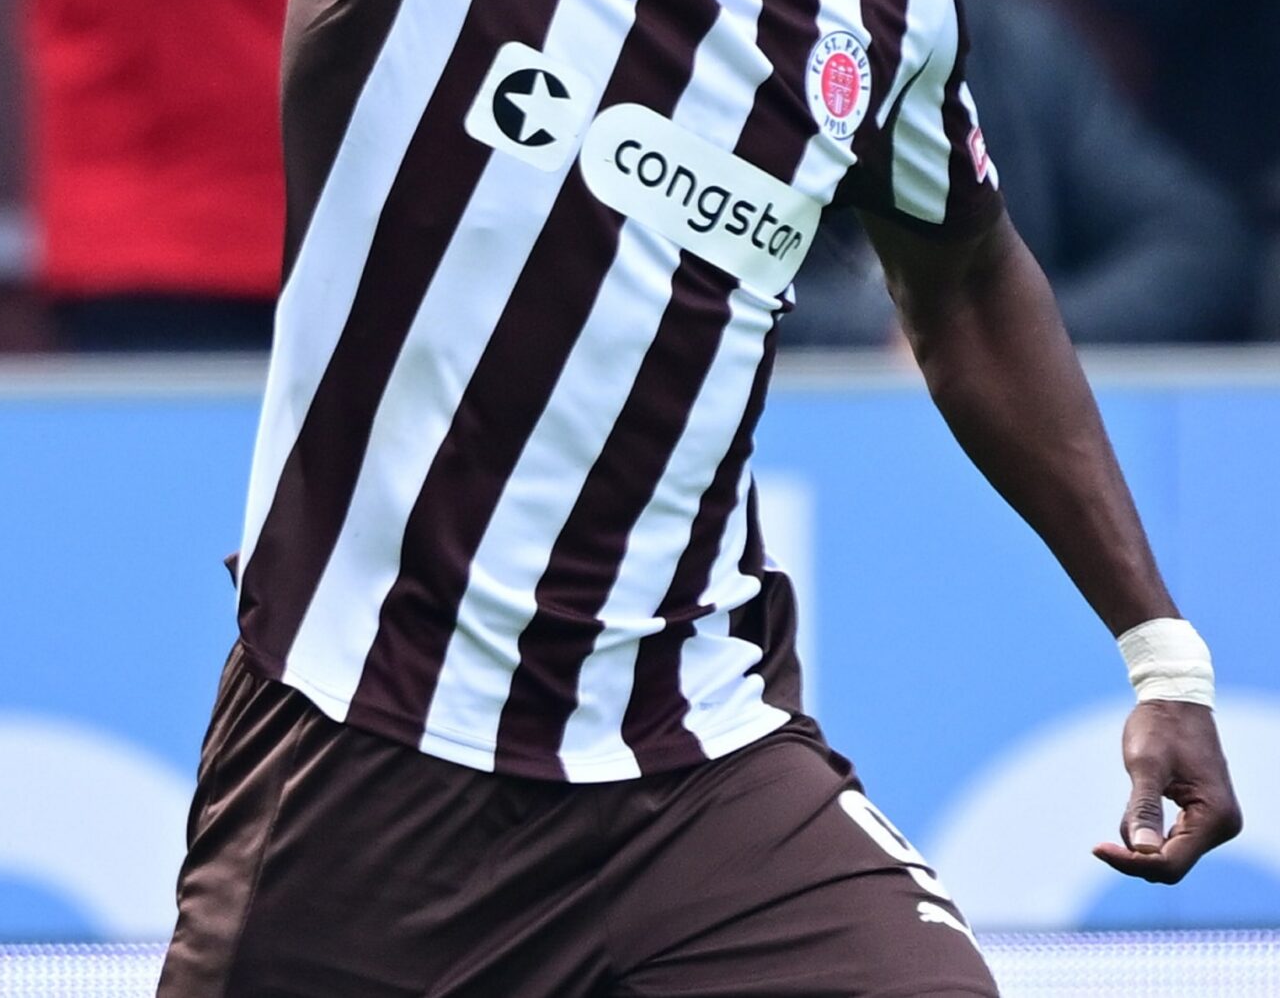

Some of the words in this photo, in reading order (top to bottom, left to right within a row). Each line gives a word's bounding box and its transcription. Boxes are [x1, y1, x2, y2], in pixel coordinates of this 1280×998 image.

[812, 54, 825, 75] FC
[845, 39, 869, 91] PAULI
[824, 115, 847, 135] 1910
[614, 139, 803, 261] congstar
